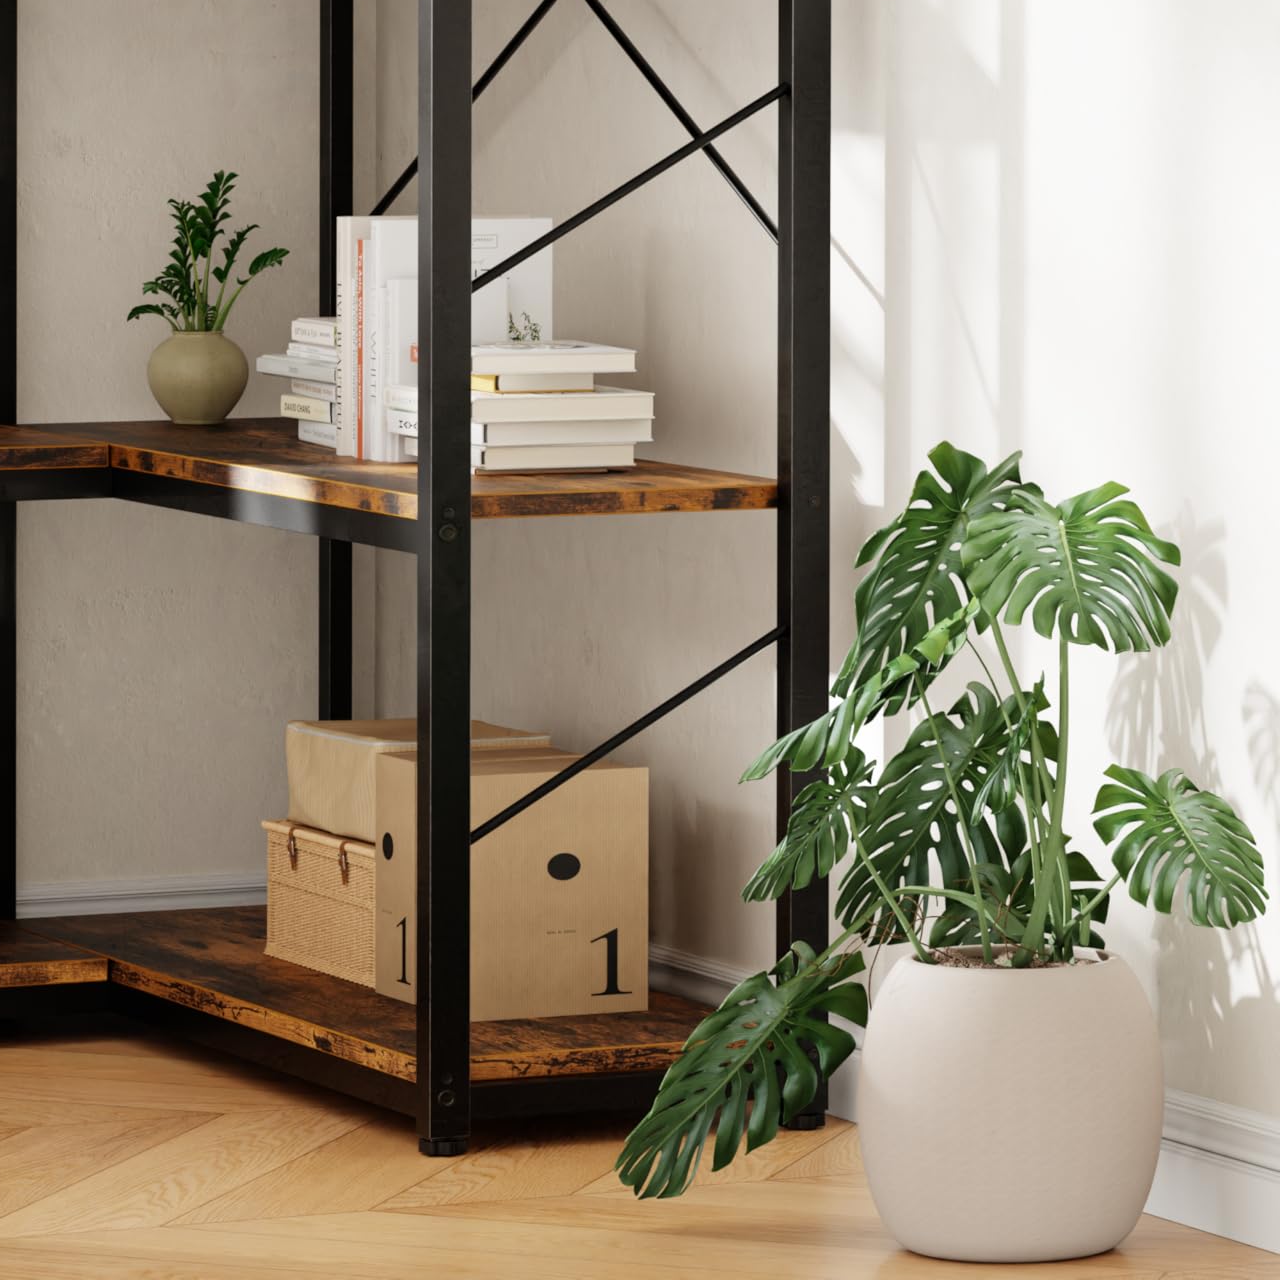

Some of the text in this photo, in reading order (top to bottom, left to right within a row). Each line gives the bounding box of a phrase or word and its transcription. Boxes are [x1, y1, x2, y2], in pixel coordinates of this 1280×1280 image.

[284, 402, 311, 414] DAVID CHANG
[396, 916, 411, 986] 1
[590, 927, 633, 997] 1
